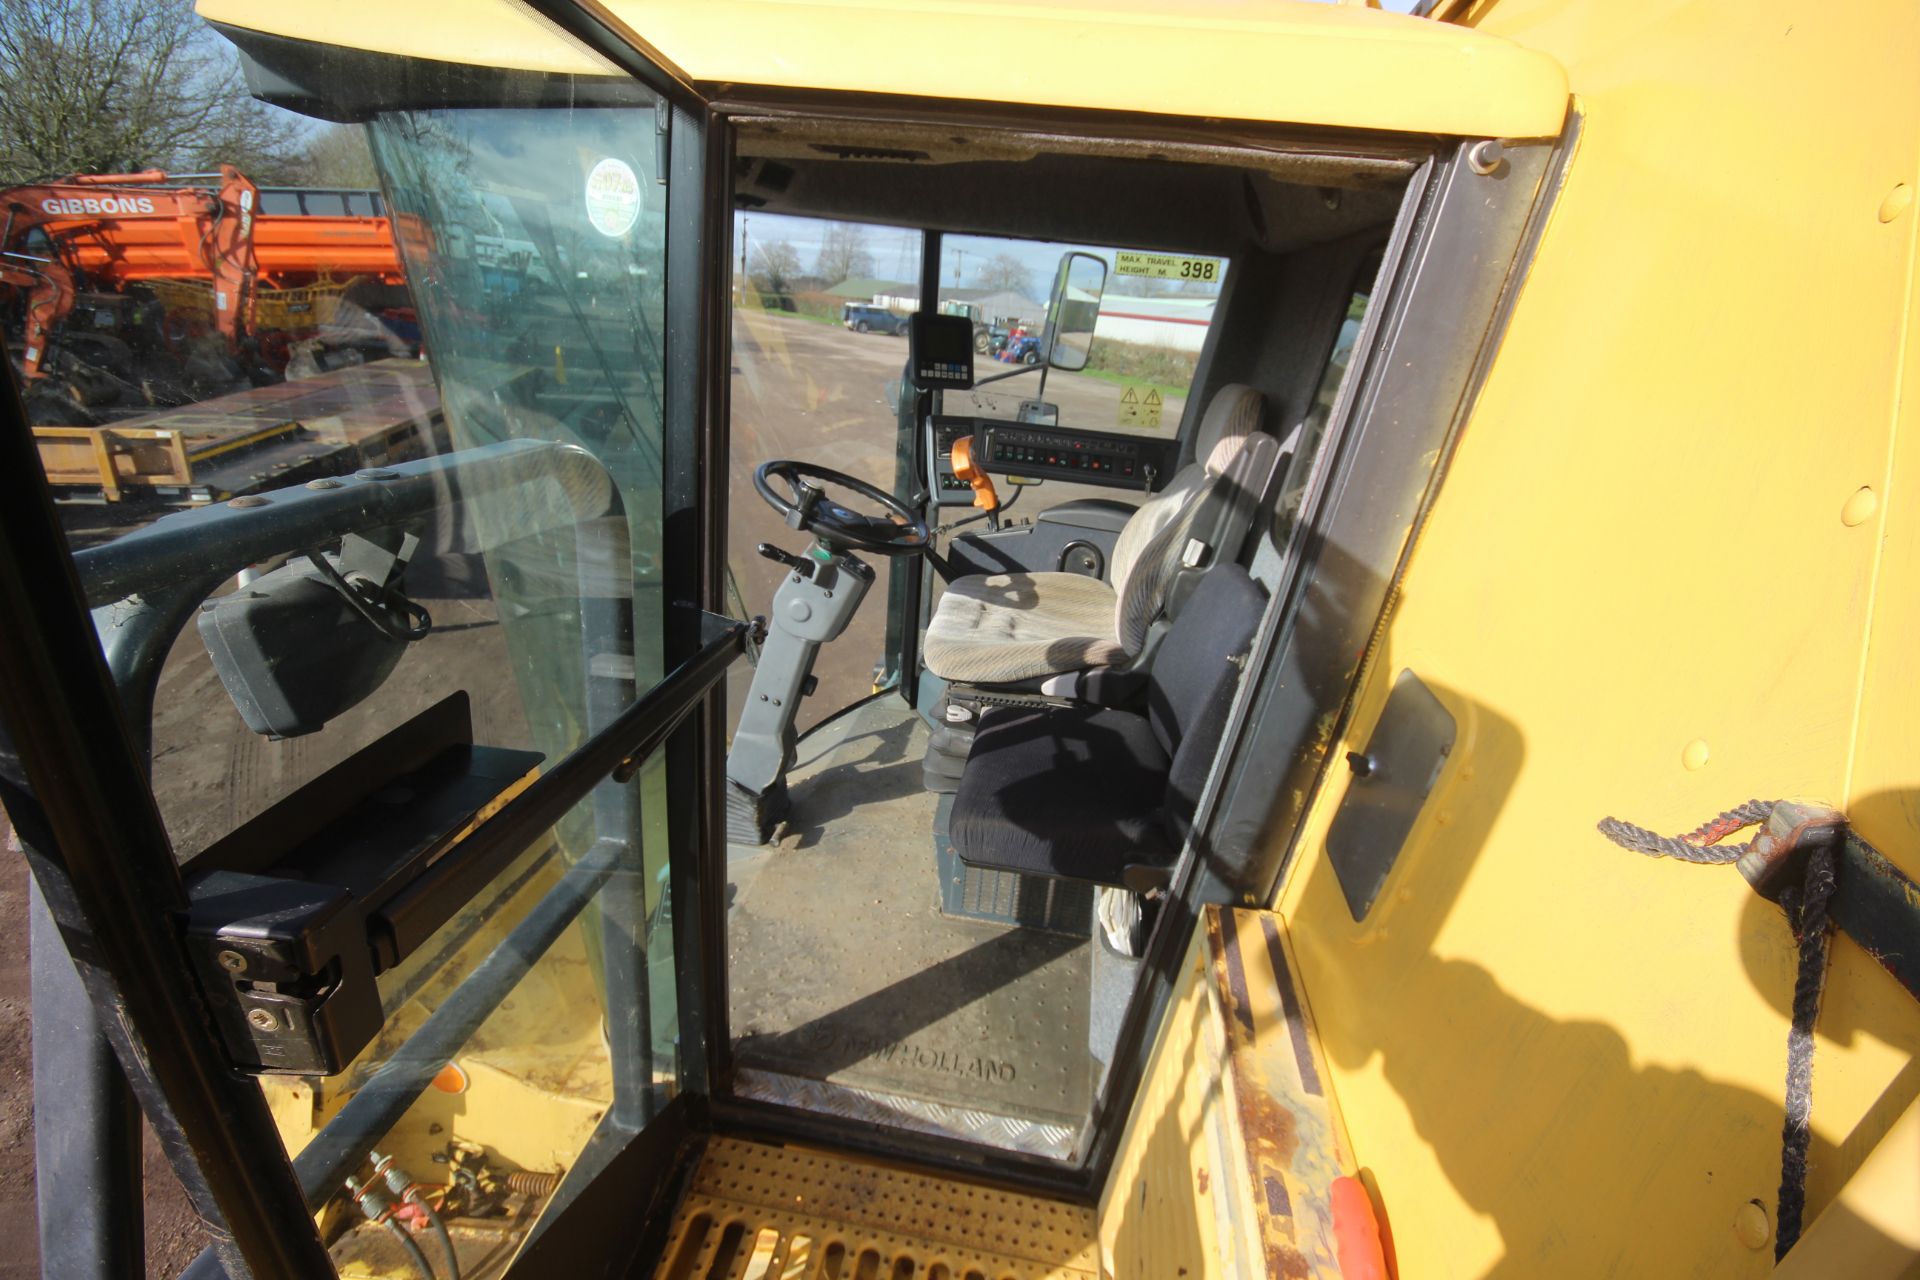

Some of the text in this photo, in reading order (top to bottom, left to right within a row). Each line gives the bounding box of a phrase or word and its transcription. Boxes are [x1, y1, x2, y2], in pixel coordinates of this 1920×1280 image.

[41, 197, 155, 215] GIBBONS
[1119, 265, 1150, 275] HEIGHT
[1120, 255, 1177, 267] MAX TRAVEL
[1180, 261, 1215, 280] 398
[899, 1044, 1016, 1083] HOLLAND
